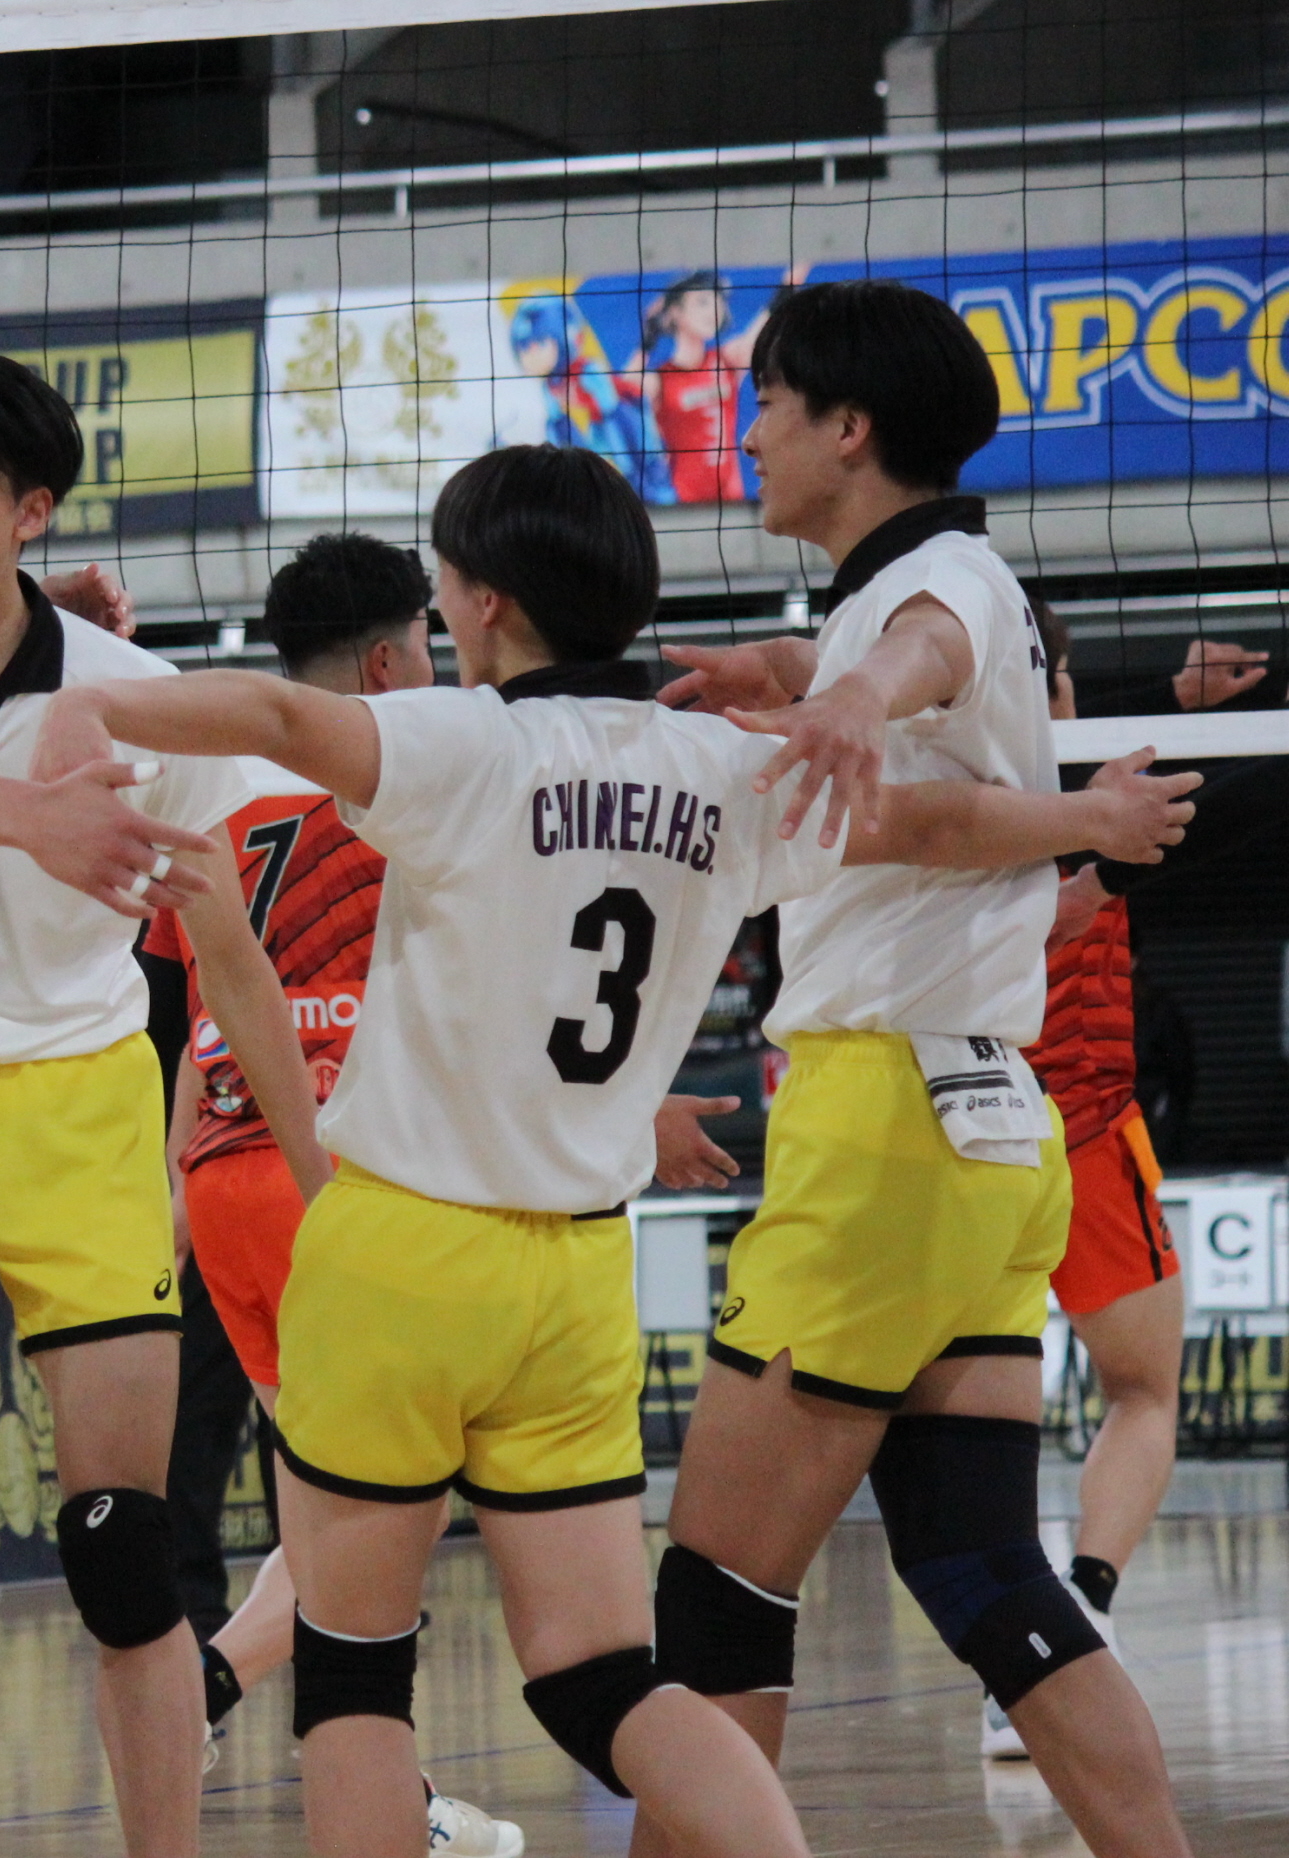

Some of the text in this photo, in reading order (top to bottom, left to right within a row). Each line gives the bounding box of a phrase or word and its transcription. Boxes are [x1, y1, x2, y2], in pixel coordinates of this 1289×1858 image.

[242, 813, 306, 943] 7
[291, 993, 362, 1029] mo
[546, 886, 657, 1085] 3
[1208, 1210, 1250, 1261] C
